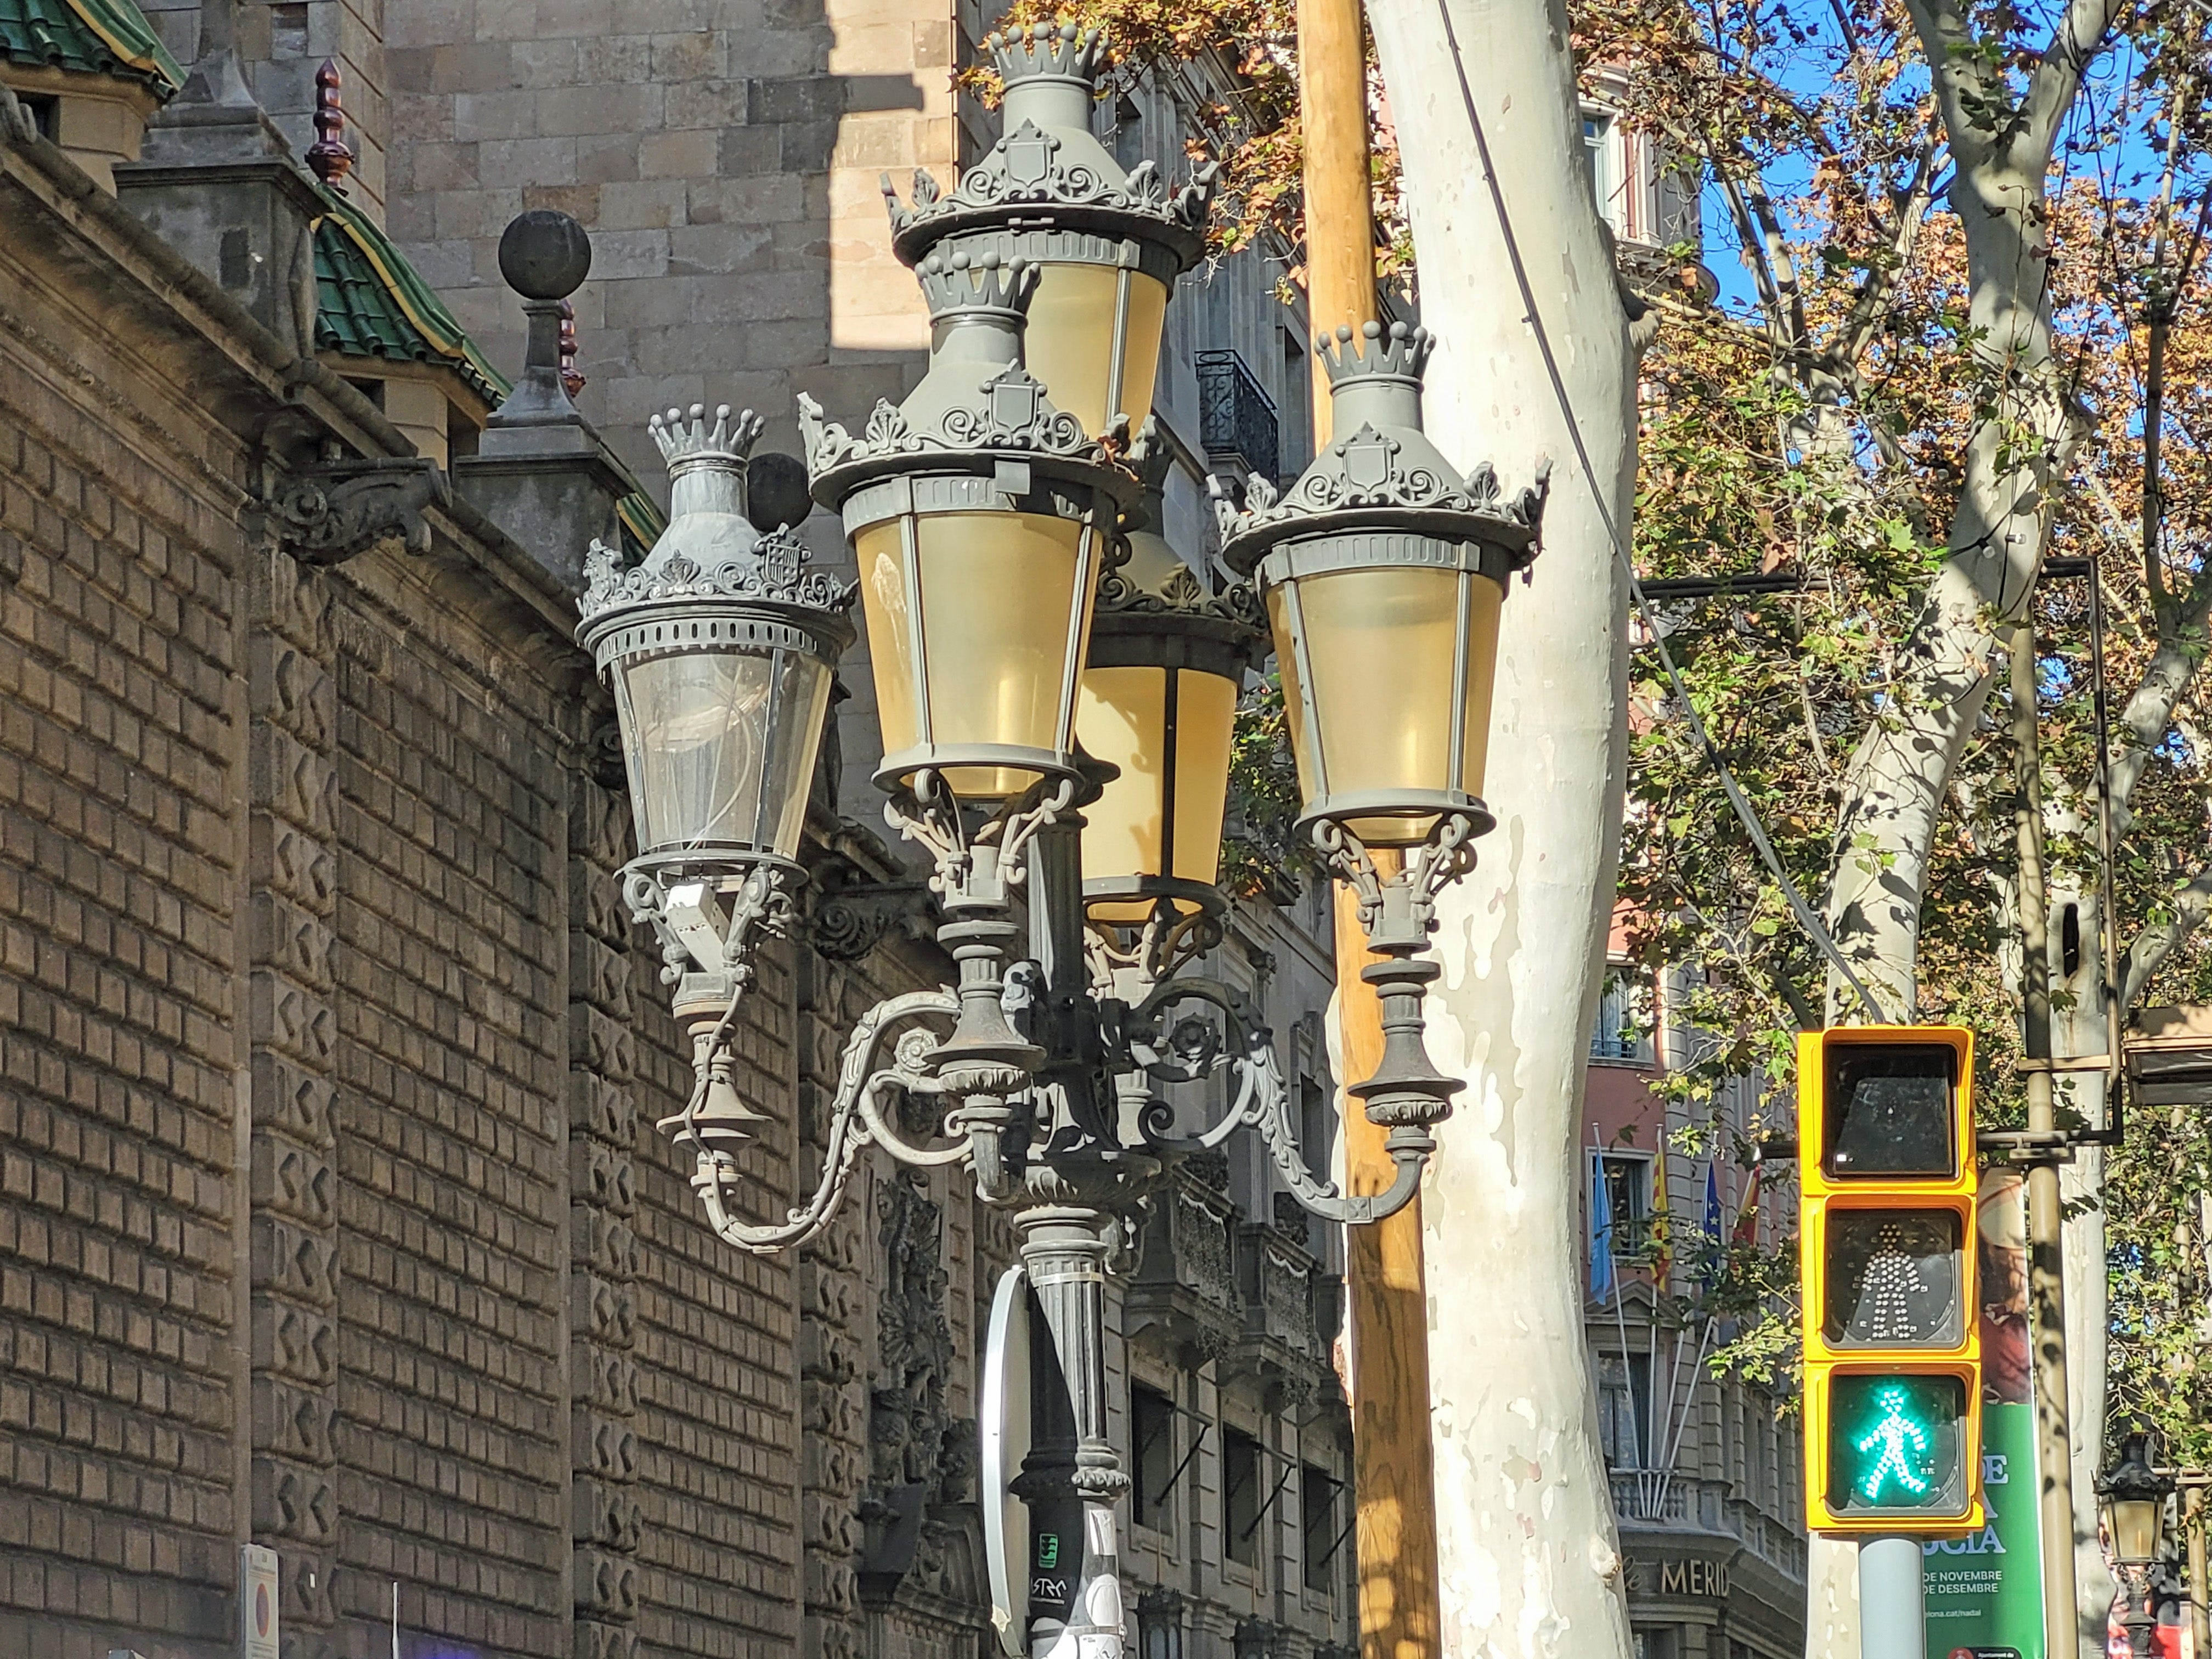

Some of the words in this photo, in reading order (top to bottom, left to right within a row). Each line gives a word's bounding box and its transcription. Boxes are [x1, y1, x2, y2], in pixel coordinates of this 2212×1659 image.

[1982, 1454, 2008, 1484] E
[1939, 1570, 2002, 1582] NOVEMBRE
[1938, 1583, 1999, 1594] DESEMBRE
